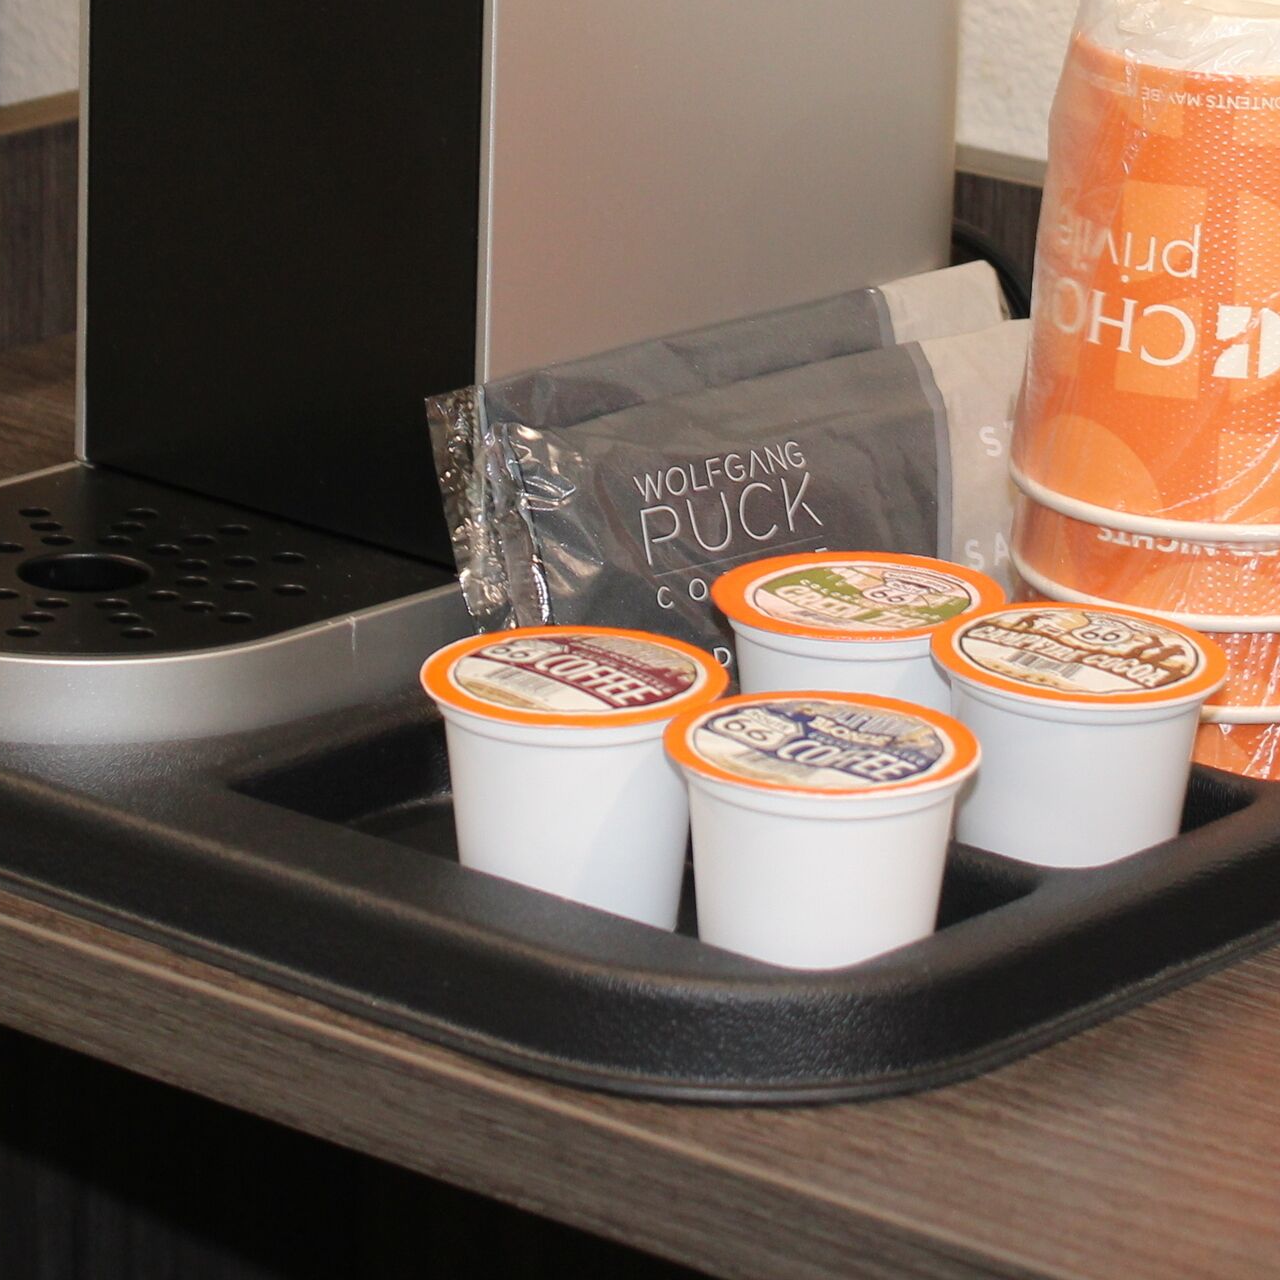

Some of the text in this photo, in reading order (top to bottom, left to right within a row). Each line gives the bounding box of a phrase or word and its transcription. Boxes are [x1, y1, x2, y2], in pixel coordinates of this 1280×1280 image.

[1141, 86, 1162, 102] BE
[1049, 280, 1197, 367] CHO
[633, 440, 807, 504] WOLFGANG
[639, 472, 823, 567] PUCK
[1080, 622, 1122, 642] 66
[534, 653, 664, 708] COFFEE
[1083, 653, 1171, 687] COCOA
[723, 715, 769, 743] 66
[775, 739, 918, 782] COFFEE
